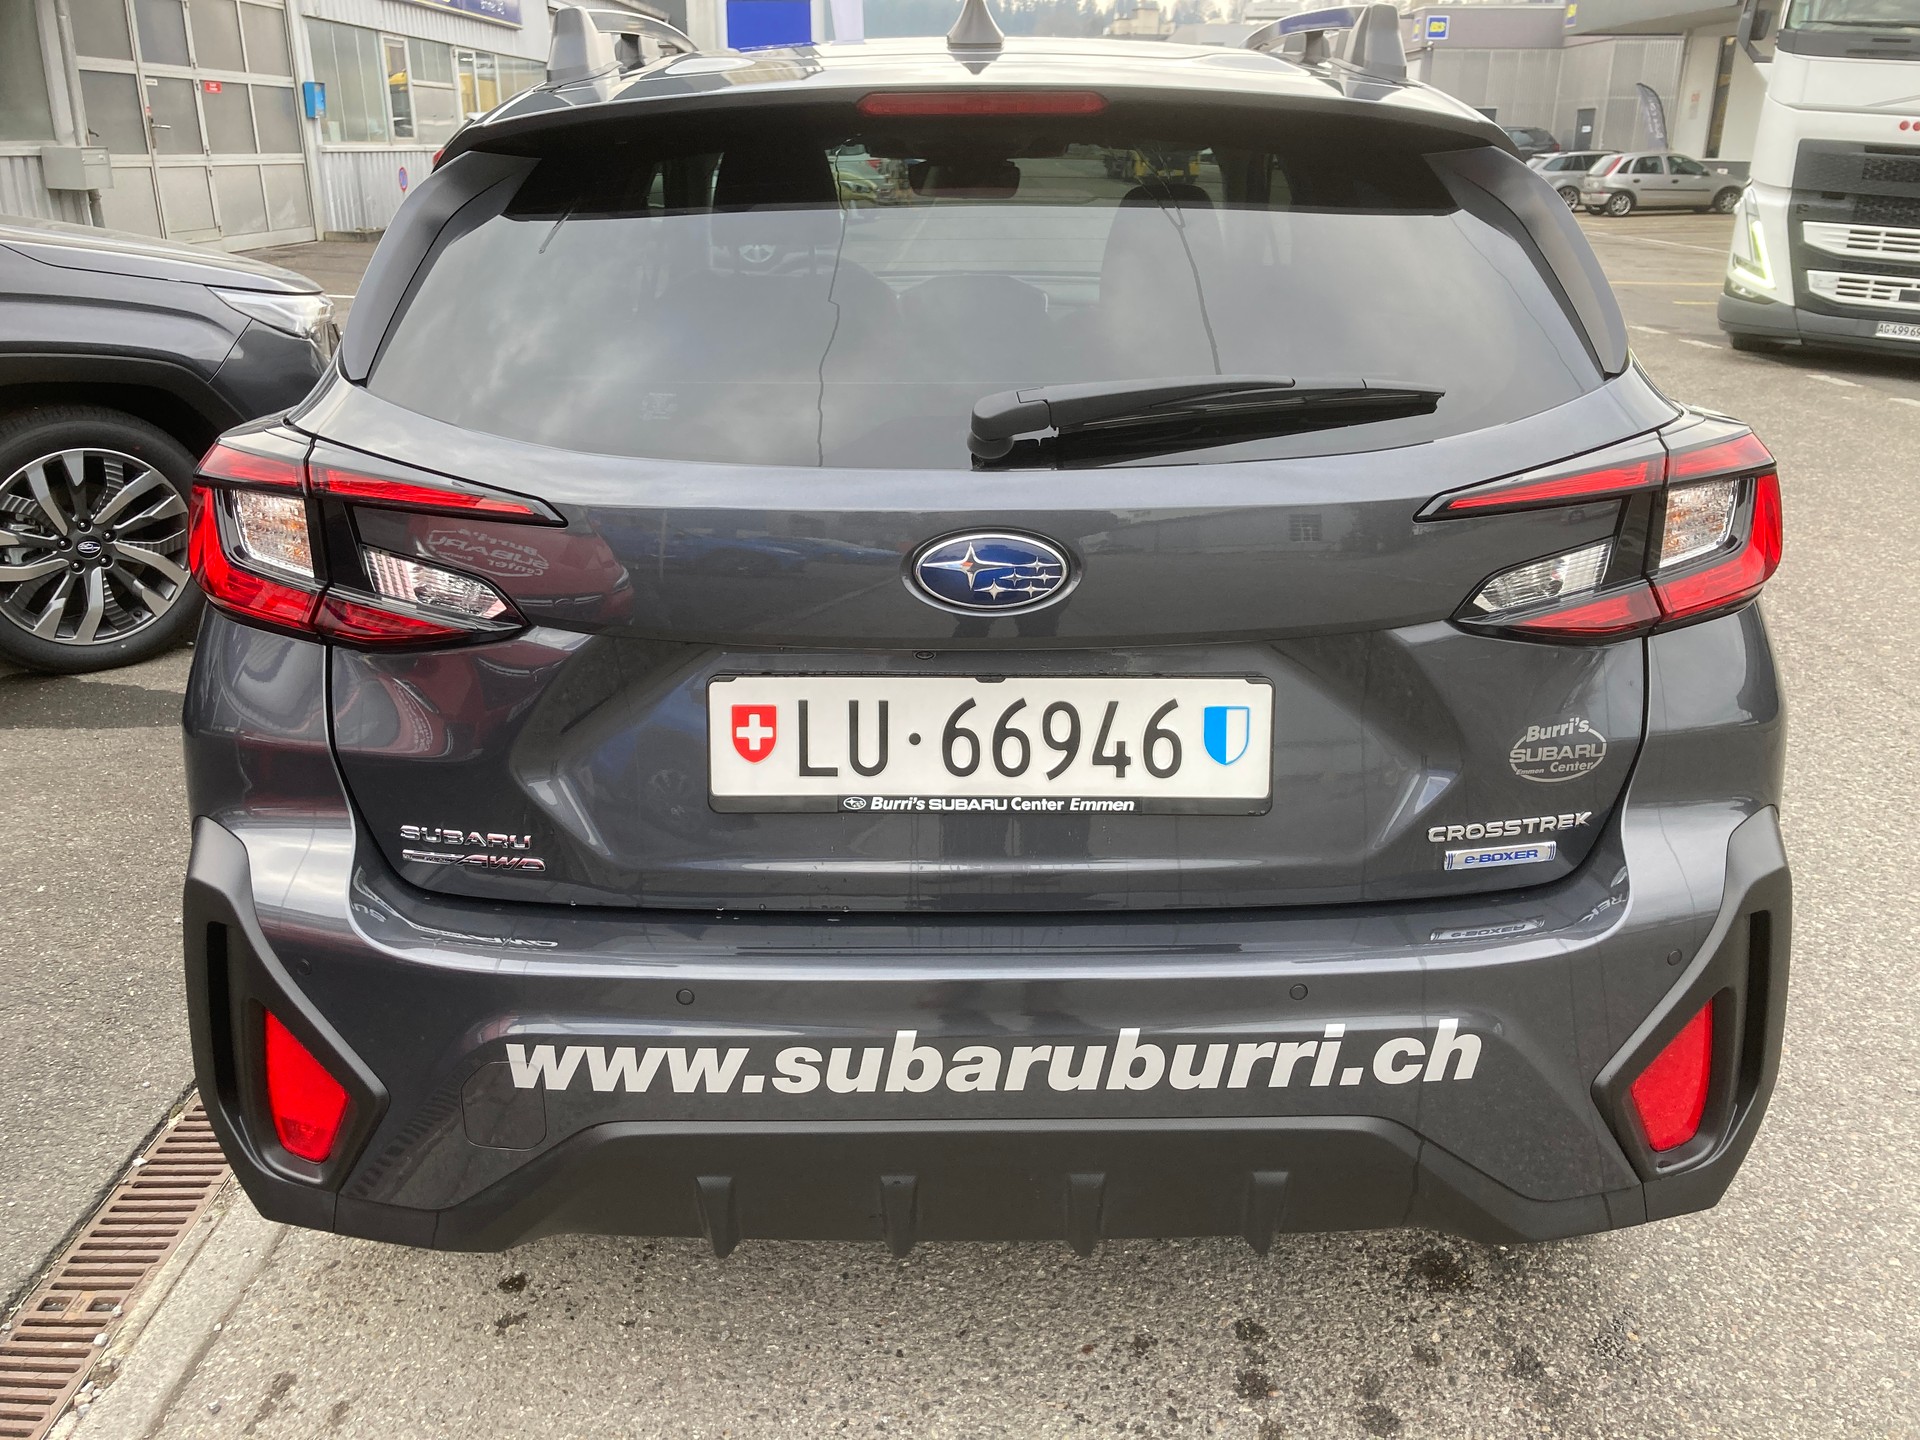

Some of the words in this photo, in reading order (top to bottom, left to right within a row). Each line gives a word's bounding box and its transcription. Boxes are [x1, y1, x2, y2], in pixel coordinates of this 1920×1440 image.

[1525, 716, 1590, 743] Burri's
[1508, 743, 1607, 763] SUBARU
[1549, 761, 1594, 773] Center
[870, 796, 926, 811] Burri's
[928, 798, 1008, 811] SUBARU
[1010, 796, 1065, 811] Center
[1069, 797, 1135, 811] Emmen
[400, 824, 532, 850] SUBARU
[1427, 810, 1593, 843] CROSSTREK
[1464, 849, 1539, 864] e-BOXER
[506, 1018, 1483, 1094] www.subaruburri.ch
